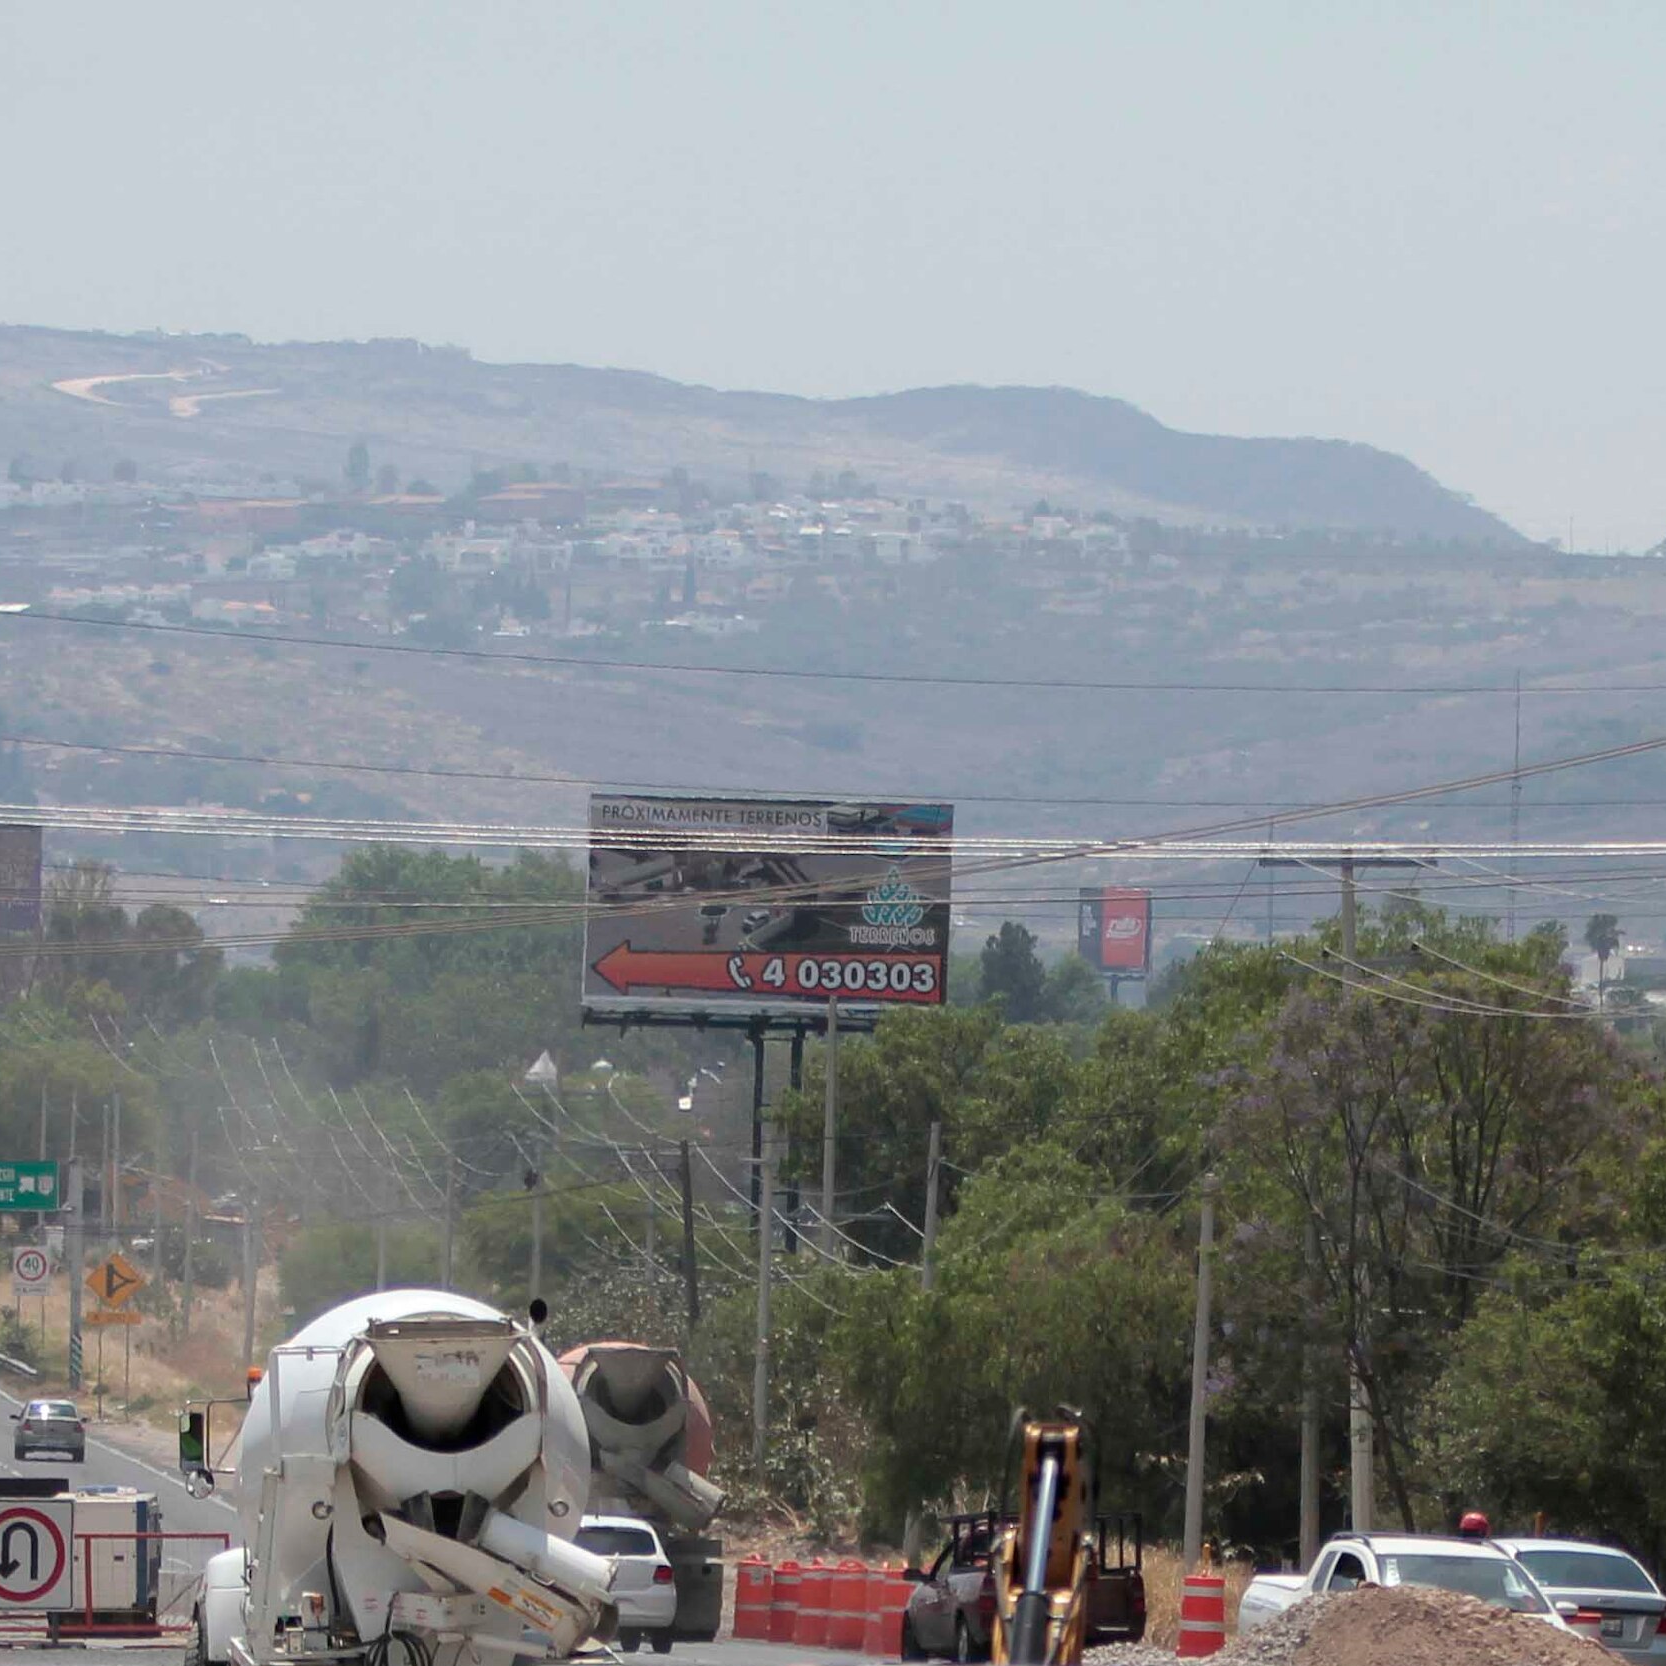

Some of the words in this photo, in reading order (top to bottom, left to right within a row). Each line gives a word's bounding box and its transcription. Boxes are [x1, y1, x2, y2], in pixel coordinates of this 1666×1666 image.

[738, 805, 823, 828] TERRENOS
[762, 958, 786, 988] 4
[797, 959, 935, 993] 030303
